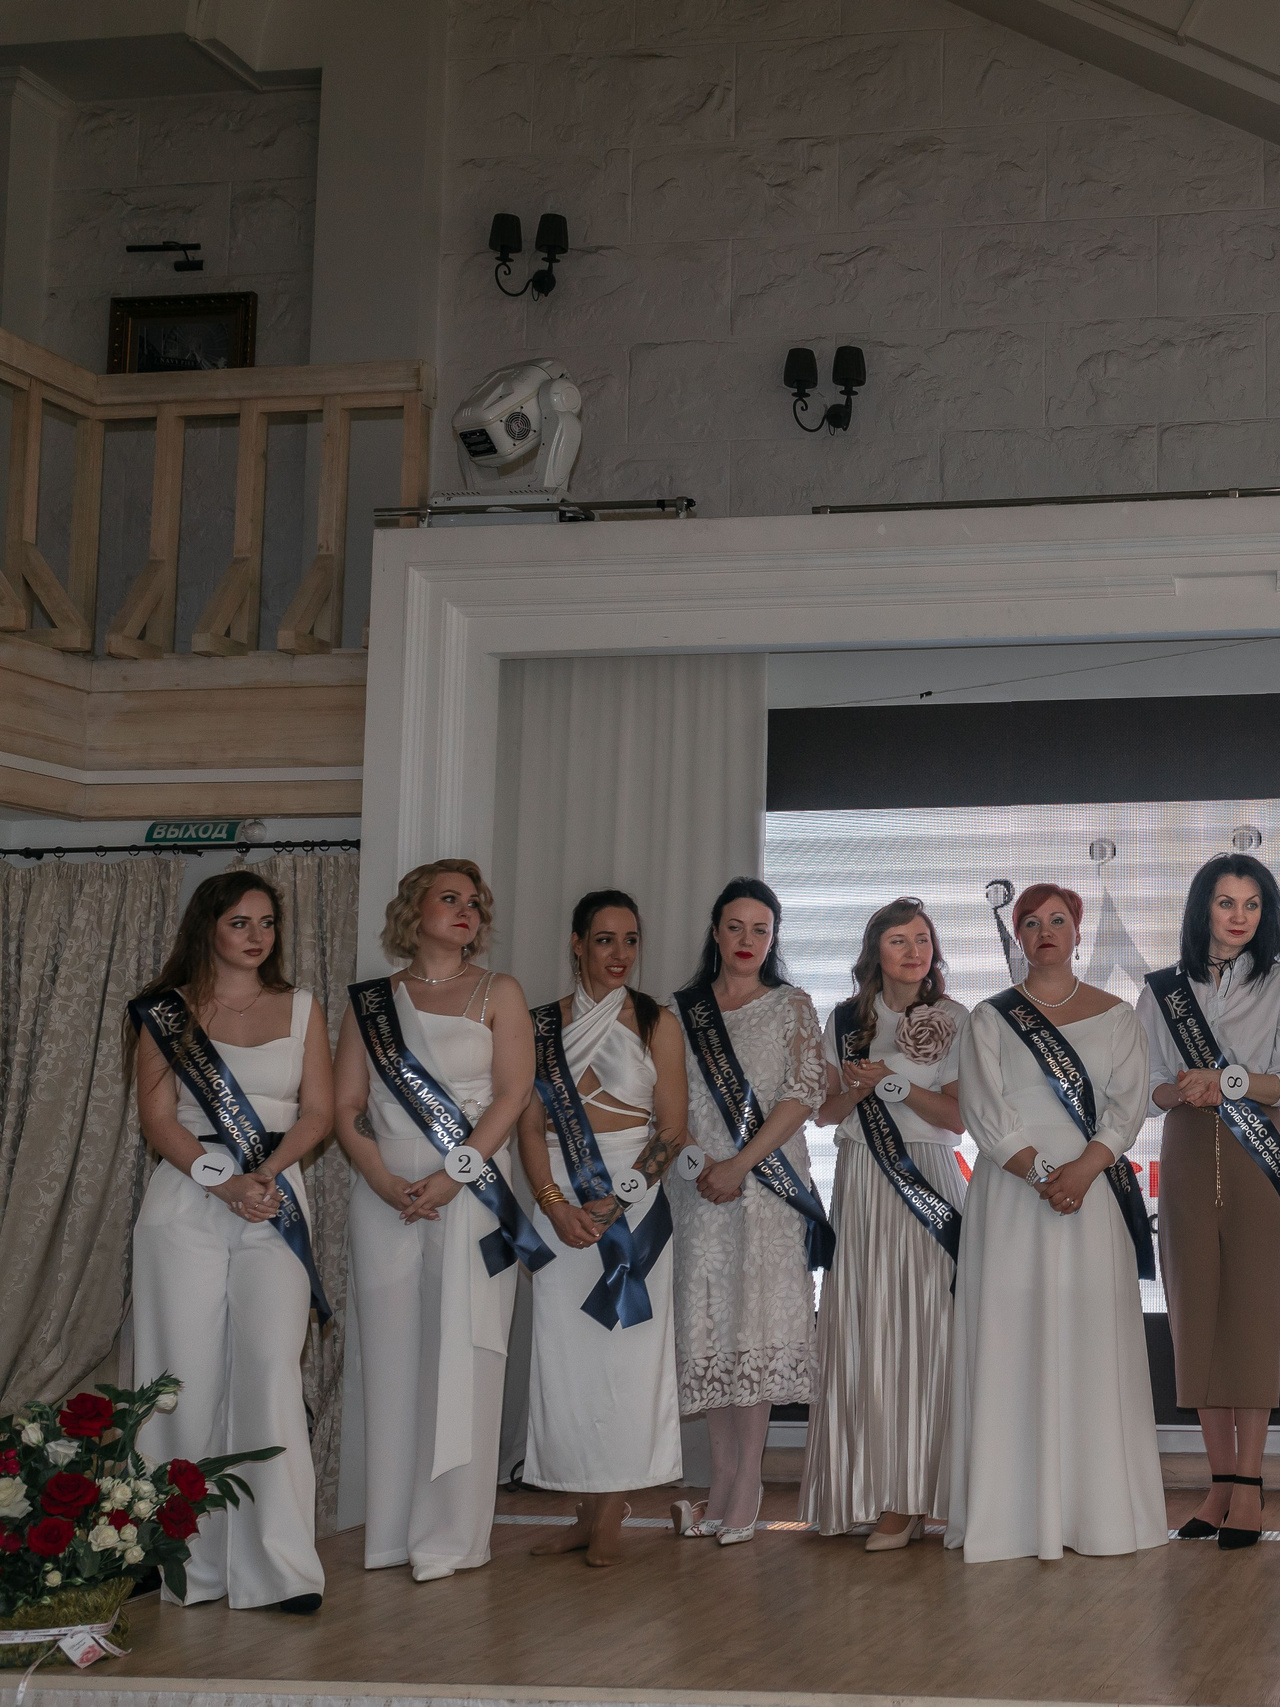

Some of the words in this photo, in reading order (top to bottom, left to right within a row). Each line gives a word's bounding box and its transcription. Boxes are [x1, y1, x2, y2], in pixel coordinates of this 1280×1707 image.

[152, 824, 229, 839] ВЫХОД
[366, 1020, 397, 1080] НОВОСИБИРСК
[393, 1078, 403, 1086] И
[376, 1014, 425, 1091] ФИНАЛИСТКА
[417, 1087, 464, 1139] МИССИС
[1028, 1032, 1071, 1091] НОВОСИБИРСК
[1066, 1088, 1074, 1098] И
[1186, 1017, 1220, 1070] ФИНАЛИС
[1235, 1099, 1268, 1138] ИССИС
[1227, 1076, 1243, 1089] 8
[211, 1100, 220, 1109] И
[696, 1030, 725, 1091] НОВОСИБИРСК
[723, 1093, 750, 1143] НОВОСИБИ
[706, 1027, 744, 1101] ФИНАЛИСТКА
[739, 1100, 760, 1139] МИСС
[765, 1152, 799, 1197] БИЗНЕС
[883, 1081, 903, 1095] 5
[1039, 1028, 1085, 1097] ФИНАЛИСТК
[1116, 1160, 1131, 1193] ИЗНЕС
[1176, 1022, 1205, 1068] НОВОСИБИР
[1223, 1100, 1265, 1153] ОСИБИРСКАЯ
[215, 1108, 257, 1172] НОВОСИБИРС
[237, 1113, 266, 1164] МИССИ
[458, 1154, 472, 1174] 2
[555, 1107, 589, 1187] НОВОСИБИРСКАЯ
[568, 1118, 598, 1176] МИССИС
[687, 1154, 700, 1171] 4
[202, 1164, 226, 1176] 1
[620, 1178, 639, 1193] 3
[871, 1129, 913, 1198] НОВОСИБИРСКАЯ
[911, 1192, 944, 1230] ОБЛАСТЬ
[913, 1177, 953, 1223] БИЗНЕС
